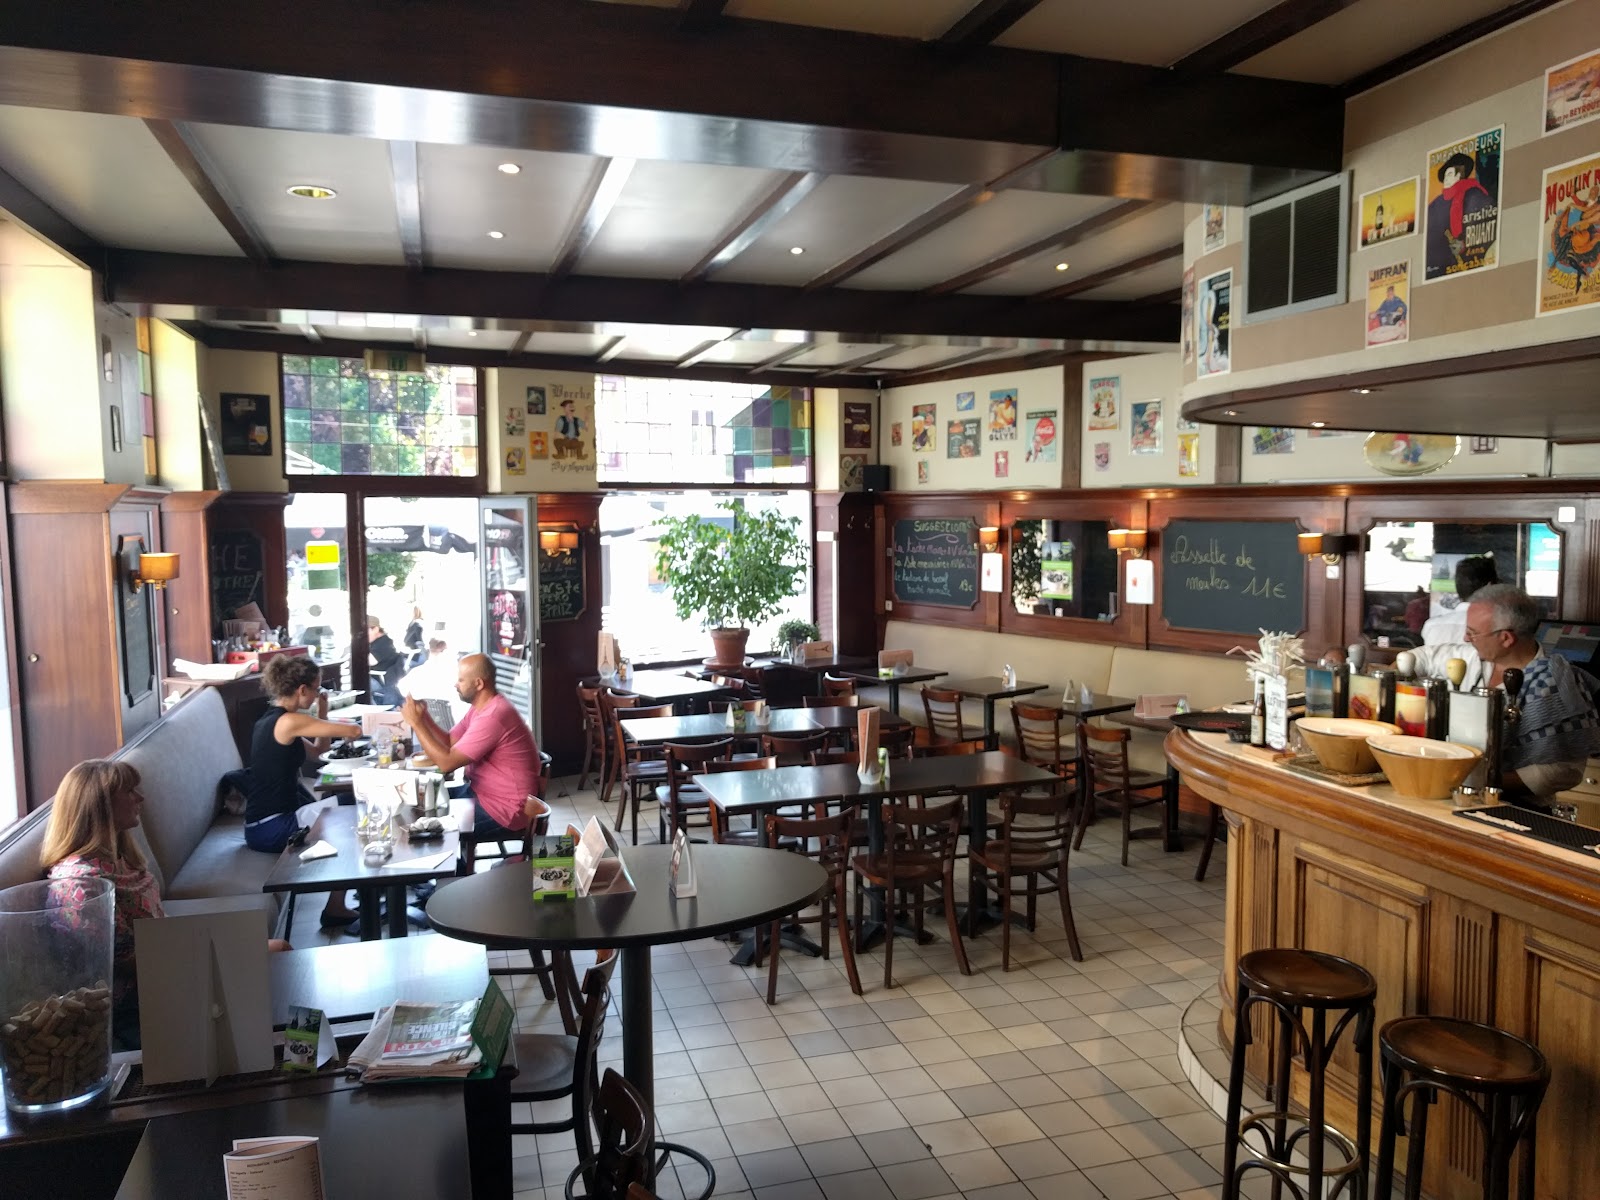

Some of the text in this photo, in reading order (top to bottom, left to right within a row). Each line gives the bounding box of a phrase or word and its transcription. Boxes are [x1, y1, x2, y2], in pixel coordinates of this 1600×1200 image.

[1429, 129, 1500, 166] AMBASSADEURS
[1544, 169, 1592, 224] MOULIN
[1462, 205, 1498, 224] aristide
[1465, 220, 1496, 248] BRUANT
[1370, 261, 1408, 282] JIFRAN
[1546, 268, 1578, 289] PARIS
[1235, 543, 1257, 571] de
[1185, 567, 1231, 591] moules
[407, 1021, 457, 1034] SILENCE
